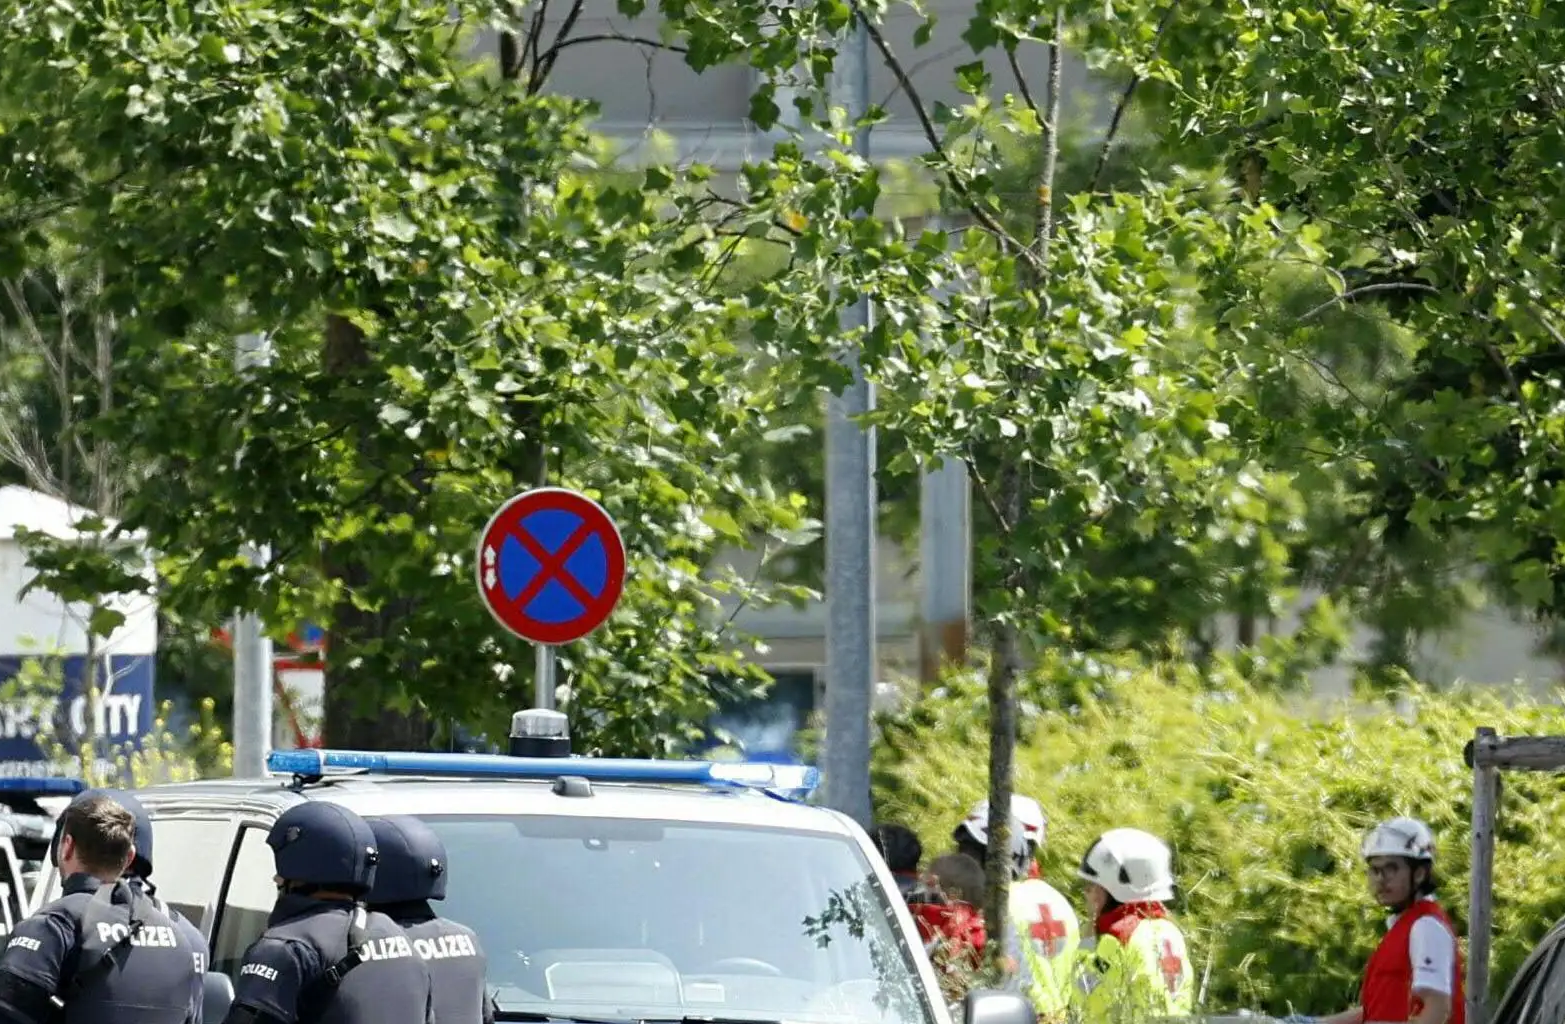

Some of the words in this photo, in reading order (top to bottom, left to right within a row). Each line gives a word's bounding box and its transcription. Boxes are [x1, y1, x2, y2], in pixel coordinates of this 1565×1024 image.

[97, 921, 177, 948] POLIZEI
[413, 934, 476, 961] OLIZEI
[359, 936, 413, 962] OLIZEI
[240, 963, 279, 982] POLIZEI
